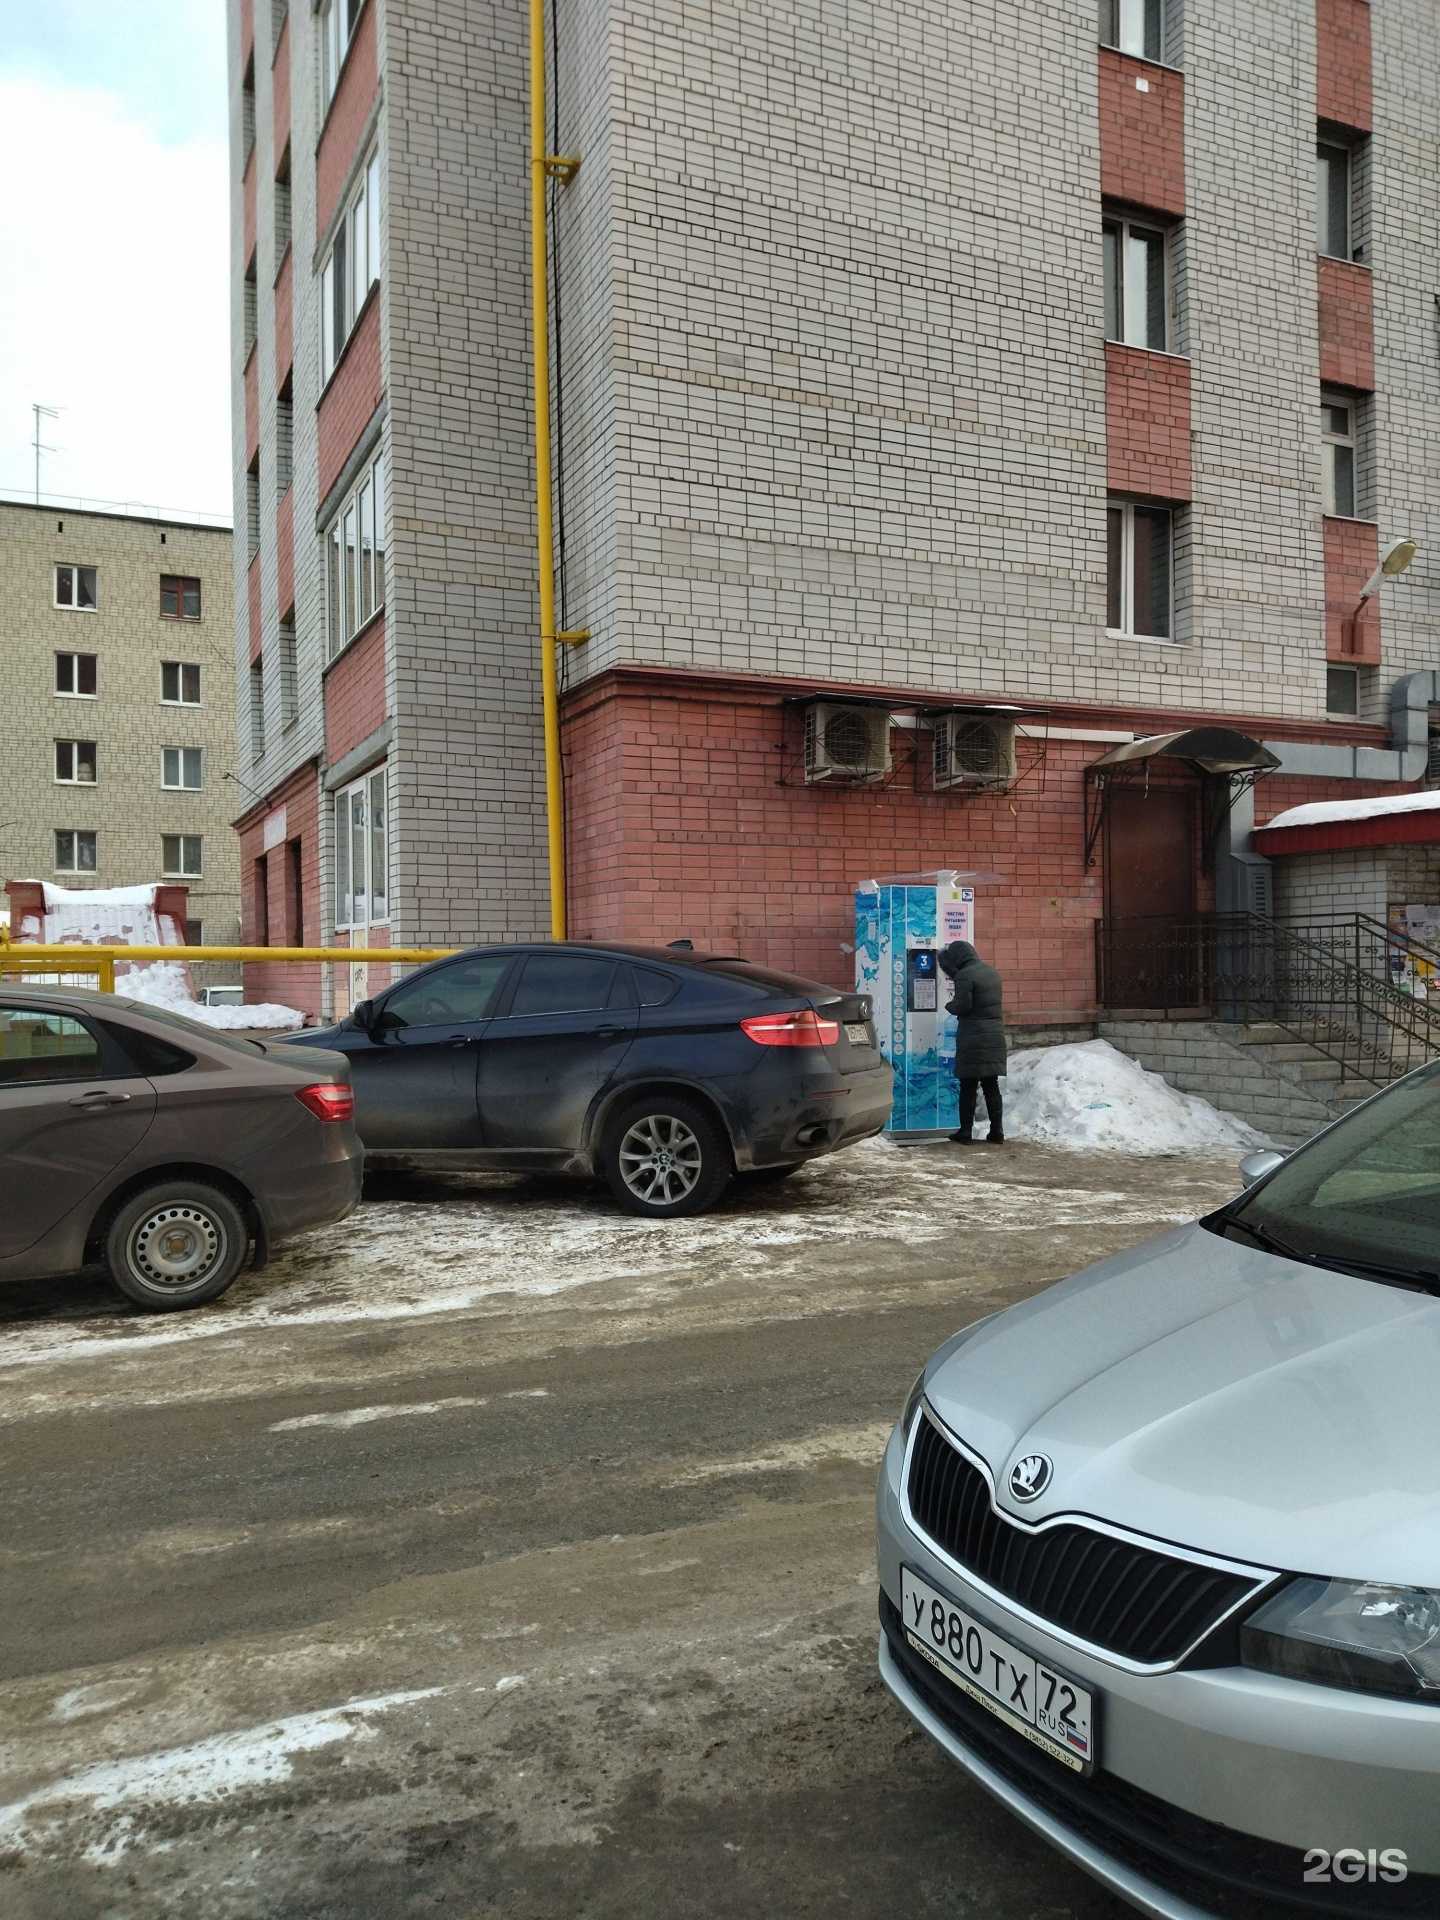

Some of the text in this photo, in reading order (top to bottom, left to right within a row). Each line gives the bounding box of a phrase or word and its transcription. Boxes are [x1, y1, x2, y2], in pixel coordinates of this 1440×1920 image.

[920, 955, 928, 967] 3
[1041, 1670, 1077, 1729] 72
[1039, 1708, 1066, 1737] RUS
